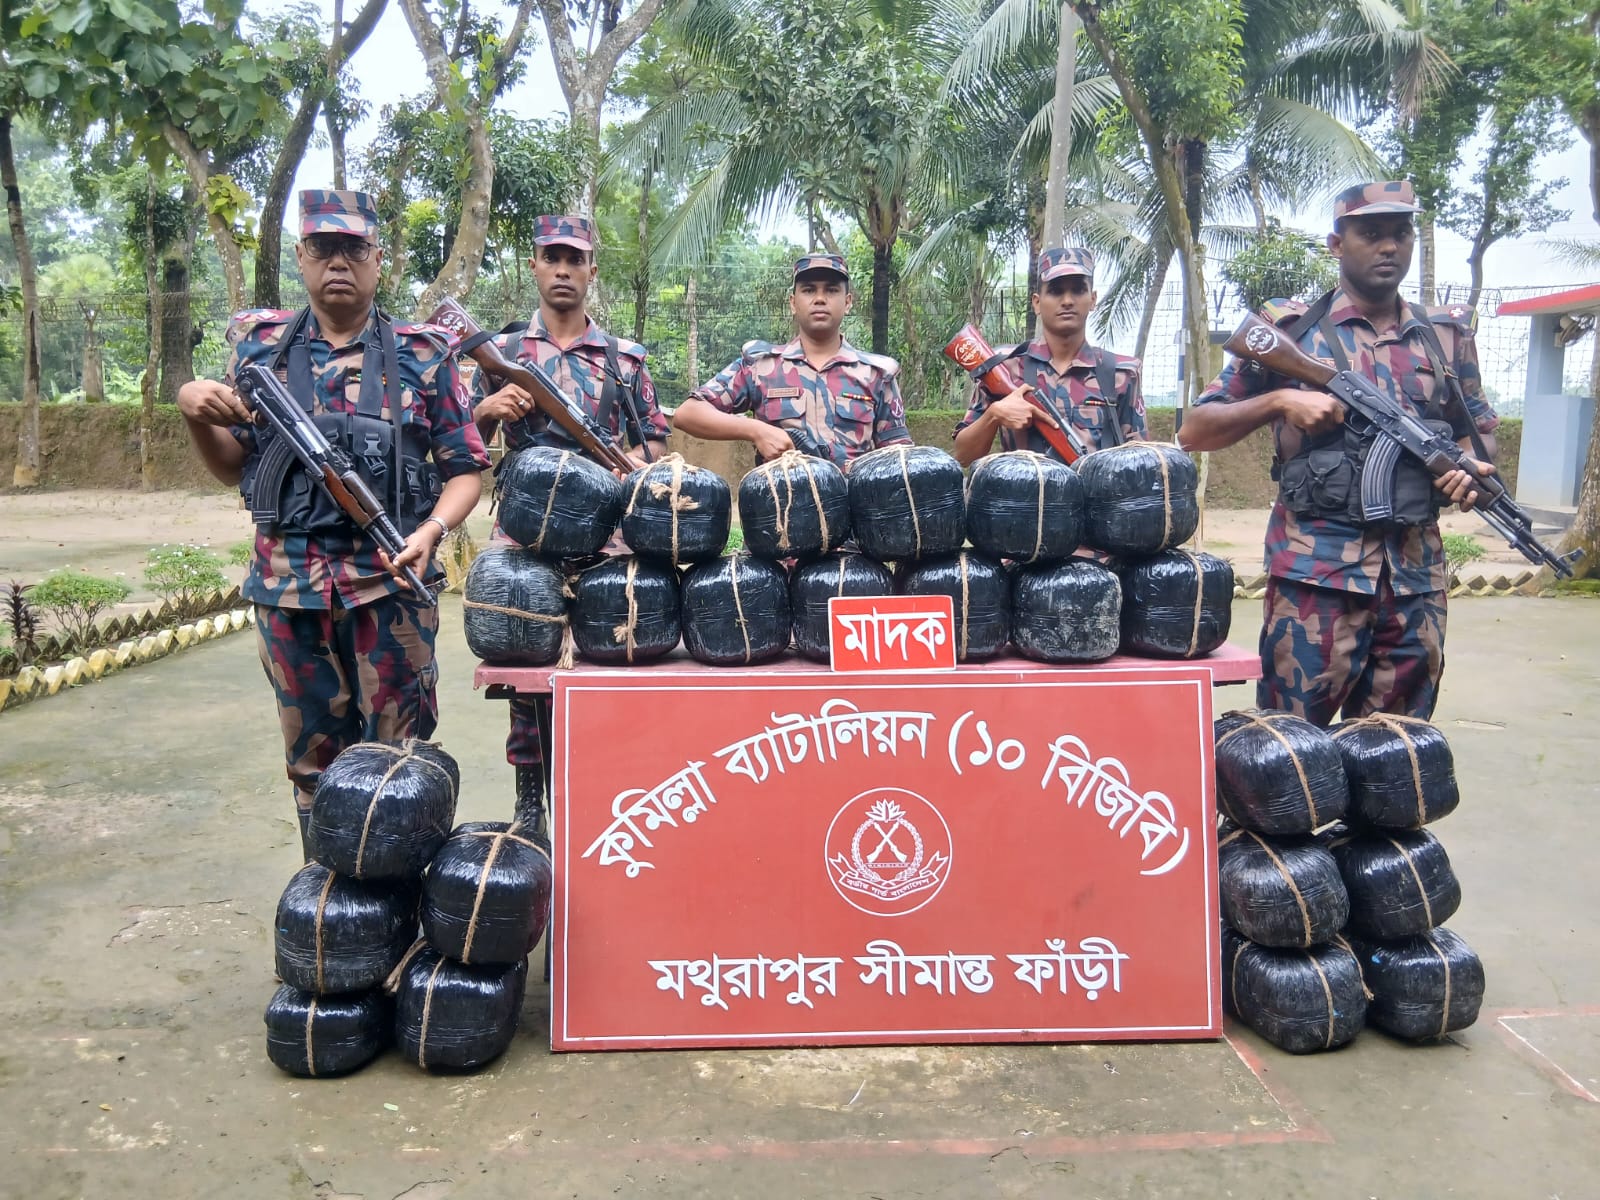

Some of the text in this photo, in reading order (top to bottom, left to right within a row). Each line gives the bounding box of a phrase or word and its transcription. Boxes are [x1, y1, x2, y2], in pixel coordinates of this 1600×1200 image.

[835, 606, 948, 663] মাদক
[582, 699, 1190, 878] কুমিল্লা ব্যাটালিয়ন (১০ বিজিবি)
[648, 937, 1130, 1011] মথুরাপুর সীমান্ত ফাঁড়ী
